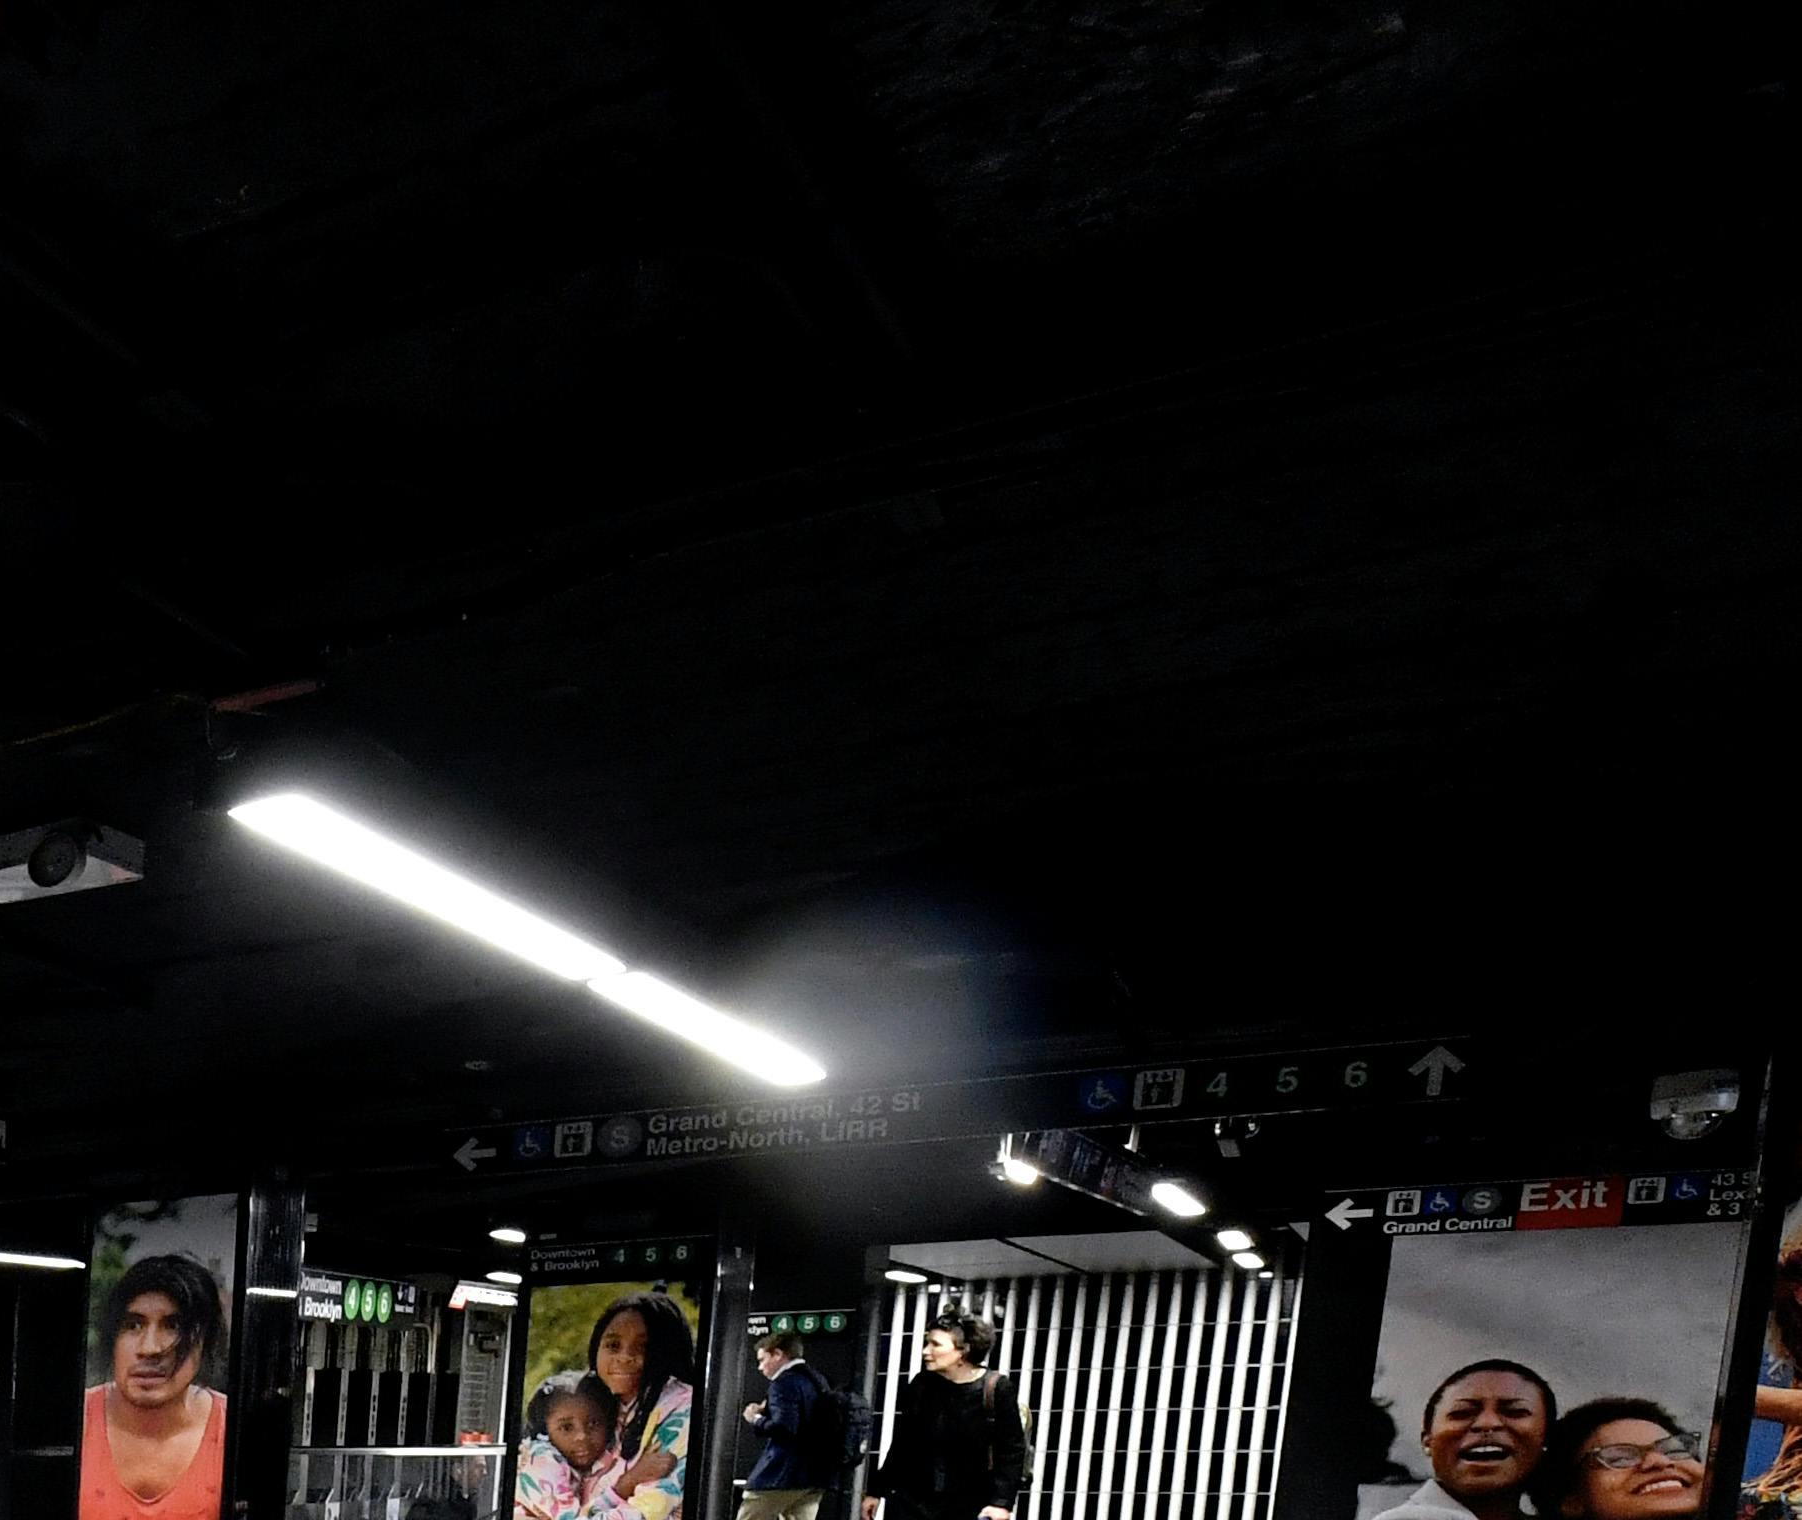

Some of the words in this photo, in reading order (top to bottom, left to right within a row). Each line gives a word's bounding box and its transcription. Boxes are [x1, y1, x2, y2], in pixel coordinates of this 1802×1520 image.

[1207, 1070, 1229, 1098] 4
[1275, 1065, 1300, 1094] 5
[1343, 1060, 1367, 1088] 6
[611, 1125, 630, 1149] S
[648, 1112, 728, 1136] Grand
[850, 1096, 881, 1116] 42
[892, 1091, 921, 1112] St
[819, 1118, 888, 1143] LIRR
[1711, 1173, 1736, 1187] 43
[1473, 1190, 1492, 1210] S
[1519, 1179, 1610, 1212] Exit
[1706, 1202, 1722, 1216] &
[1727, 1202, 1741, 1216] 3
[1383, 1219, 1440, 1235] Grand
[1445, 1215, 1513, 1231] Central
[530, 1247, 596, 1260] Downtown
[645, 1247, 656, 1262] 5
[676, 1245, 688, 1260] 6
[544, 1259, 600, 1272] Brooklyn
[305, 1297, 342, 1324] Brooklyn
